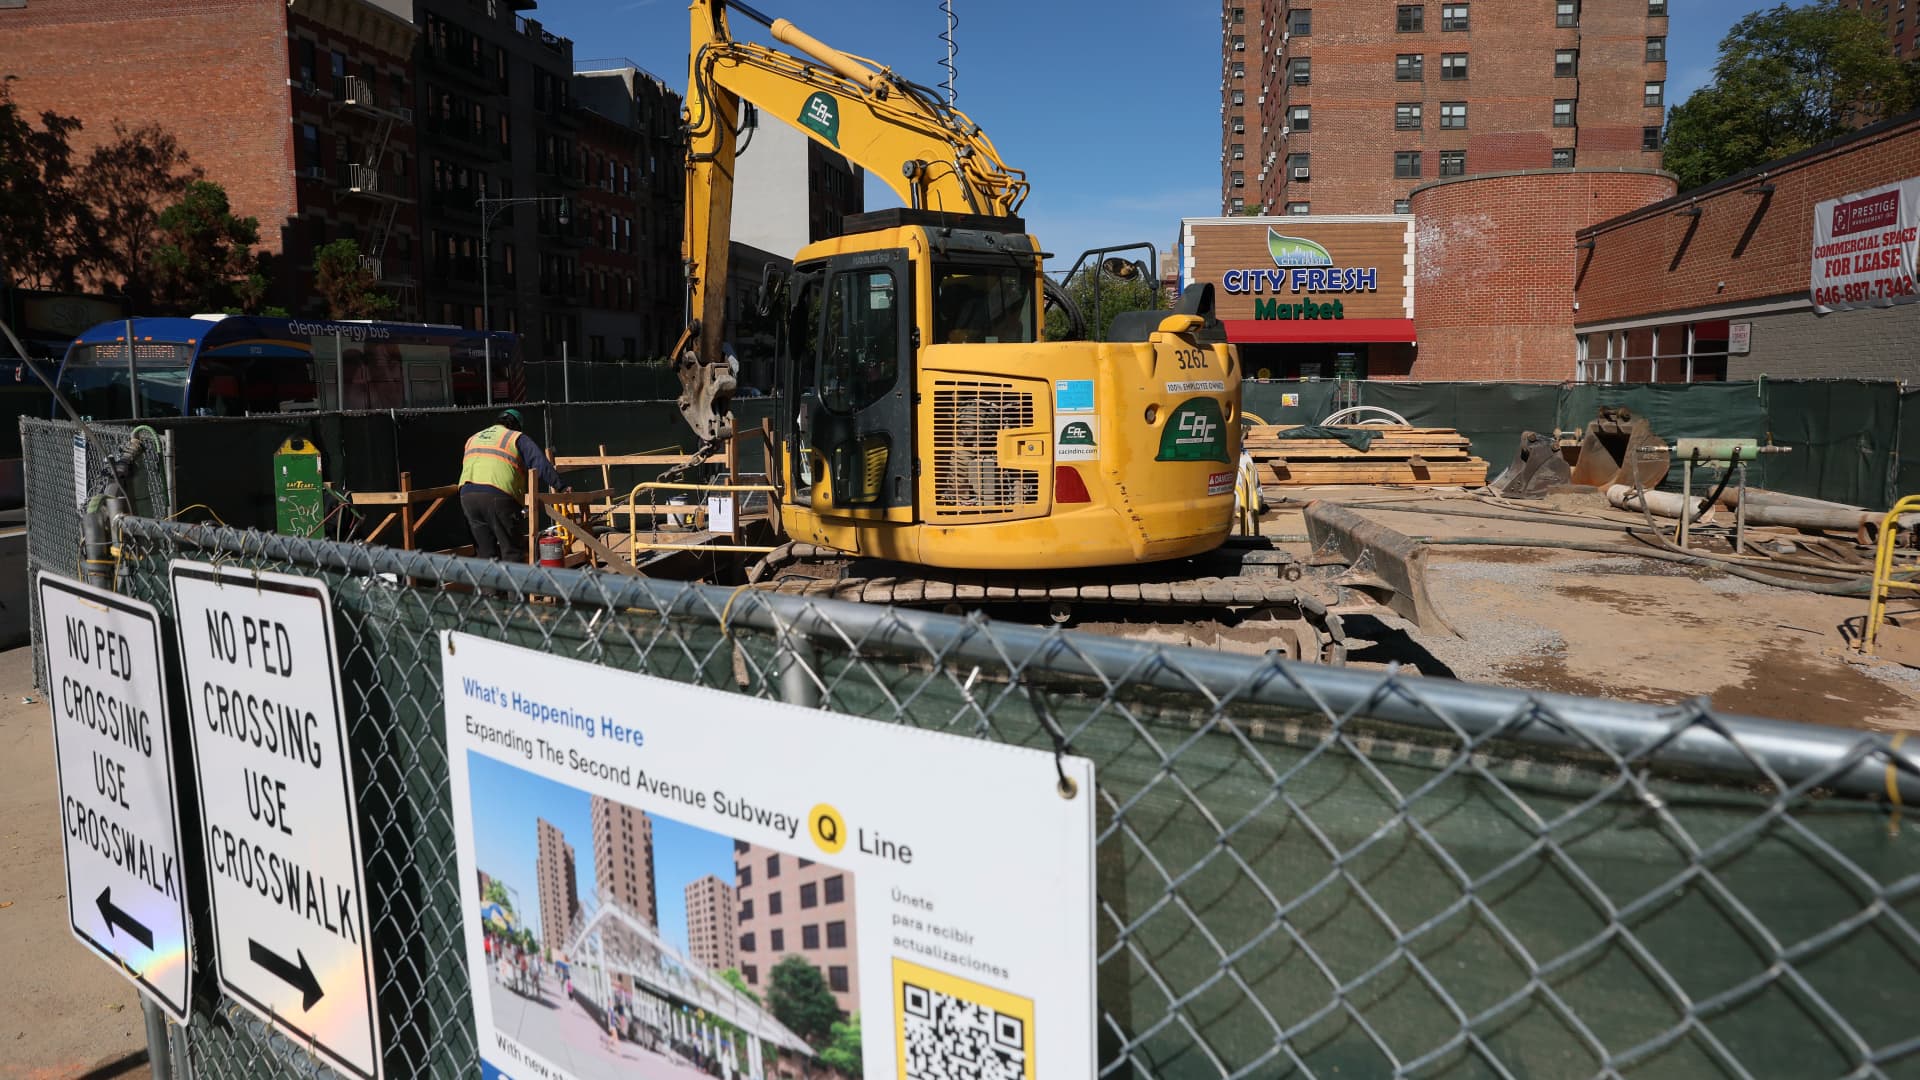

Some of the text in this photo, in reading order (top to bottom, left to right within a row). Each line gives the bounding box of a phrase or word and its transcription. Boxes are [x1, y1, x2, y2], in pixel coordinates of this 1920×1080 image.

[811, 96, 833, 126] CAC
[1852, 199, 1895, 219] PRESTIGE
[1814, 227, 1917, 259] COMMERCIAL SPACE
[1222, 267, 1377, 293] CITY FRESH
[1825, 248, 1901, 278] FOR LEASE
[1255, 297, 1344, 320] Market
[1815, 275, 1915, 306] 646-887-7342
[367, 324, 390, 339] bus
[1175, 349, 1209, 370] 3262
[1067, 426, 1087, 438] CAC
[1179, 411, 1216, 443] CAC
[65, 614, 132, 682] NO PED
[205, 608, 292, 678] NO PED
[63, 675, 152, 758] CROSSING
[203, 681, 322, 769] CROSSING
[462, 675, 645, 747] What's Happening Here
[93, 750, 130, 810] USE
[465, 714, 913, 864] Expanding The Second Avenue Subway Q Line
[244, 768, 293, 836] USE
[66, 795, 178, 903] CROSSWALK
[211, 824, 357, 945] CROSSWALK
[892, 913, 975, 945] para recibir
[893, 936, 1009, 979] actualizaciones
[495, 1031, 549, 1078] With new
